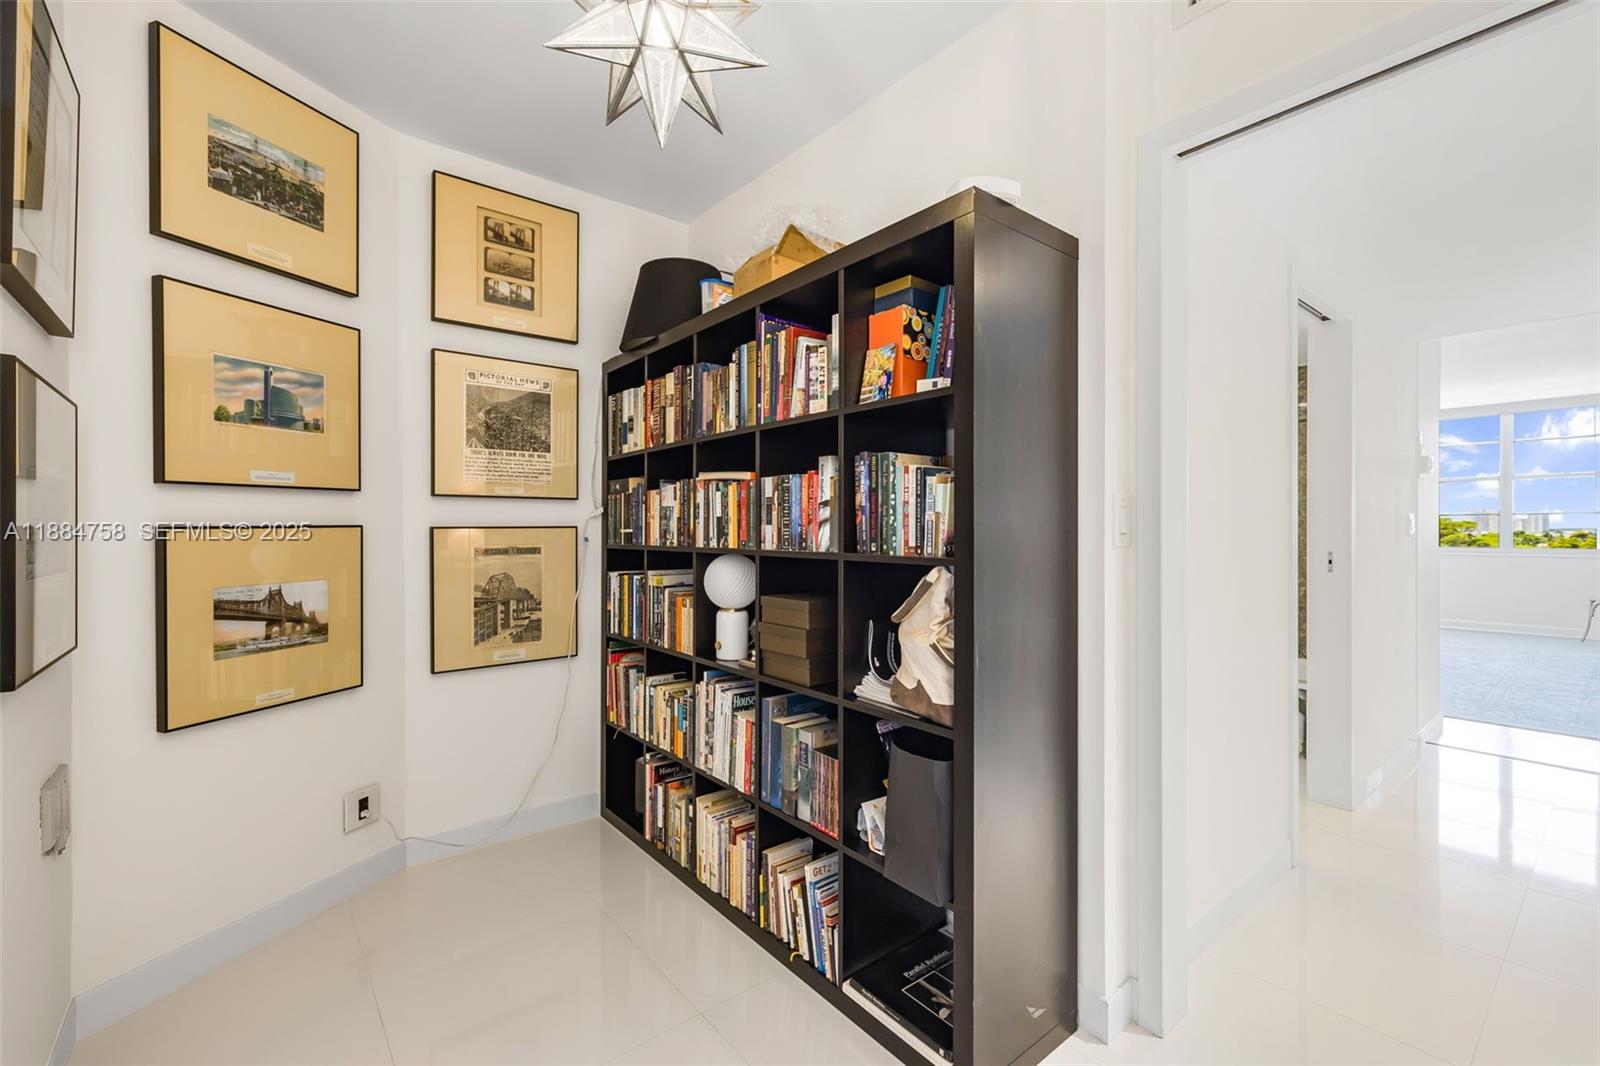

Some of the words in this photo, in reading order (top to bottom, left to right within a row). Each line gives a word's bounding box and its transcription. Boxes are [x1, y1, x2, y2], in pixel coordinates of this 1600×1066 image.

[479, 371, 518, 383] PICTORIAL
[519, 377, 540, 386] NEWS
[813, 866, 827, 877] GET
